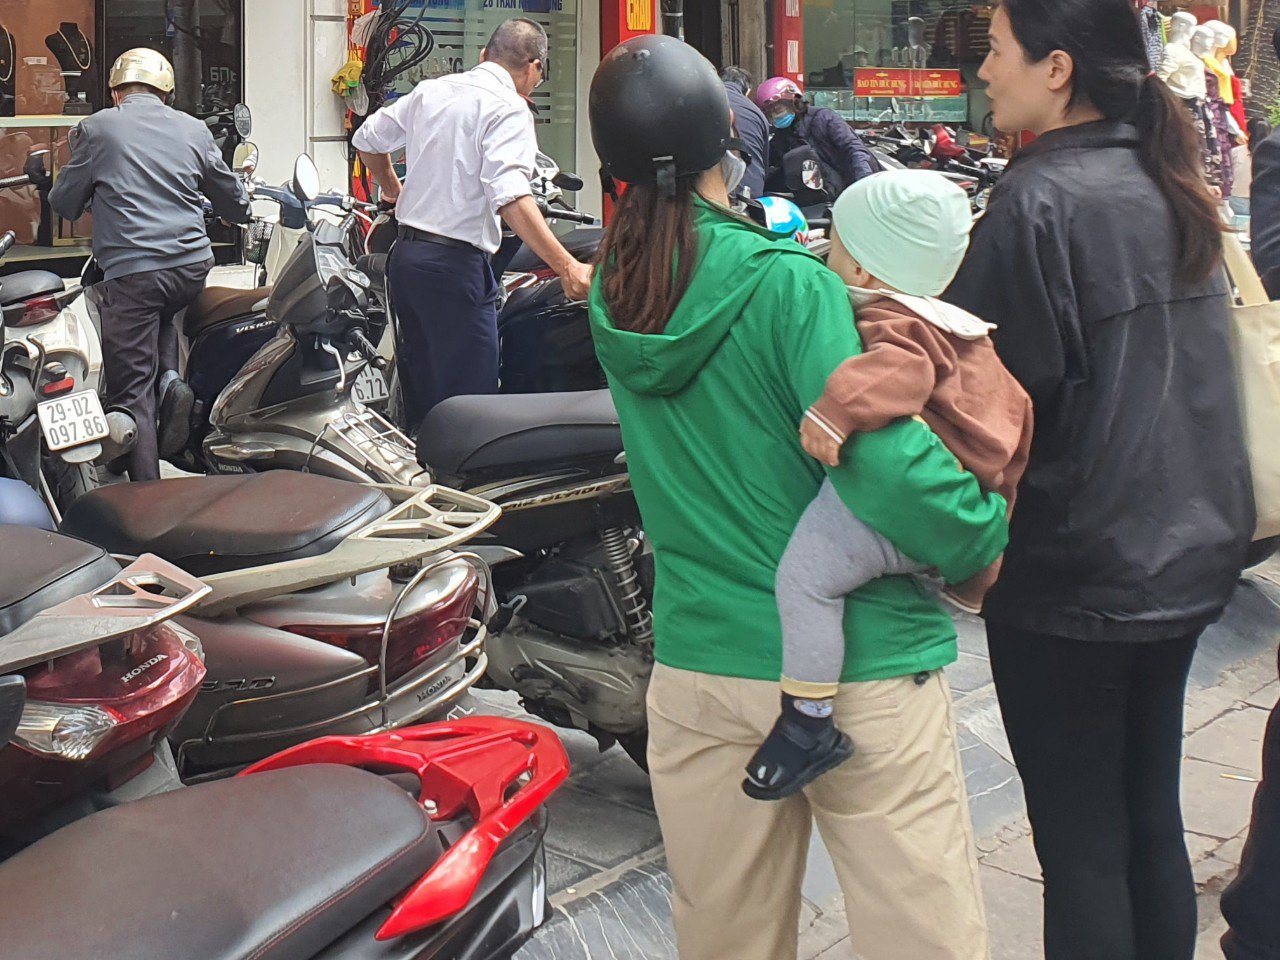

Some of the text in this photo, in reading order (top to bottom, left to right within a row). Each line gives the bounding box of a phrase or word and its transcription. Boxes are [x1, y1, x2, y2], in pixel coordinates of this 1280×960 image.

[354, 377, 387, 401] 6.72
[47, 397, 92, 424] 29-D2
[49, 416, 104, 446] 097.86
[120, 653, 169, 684] HONDA
